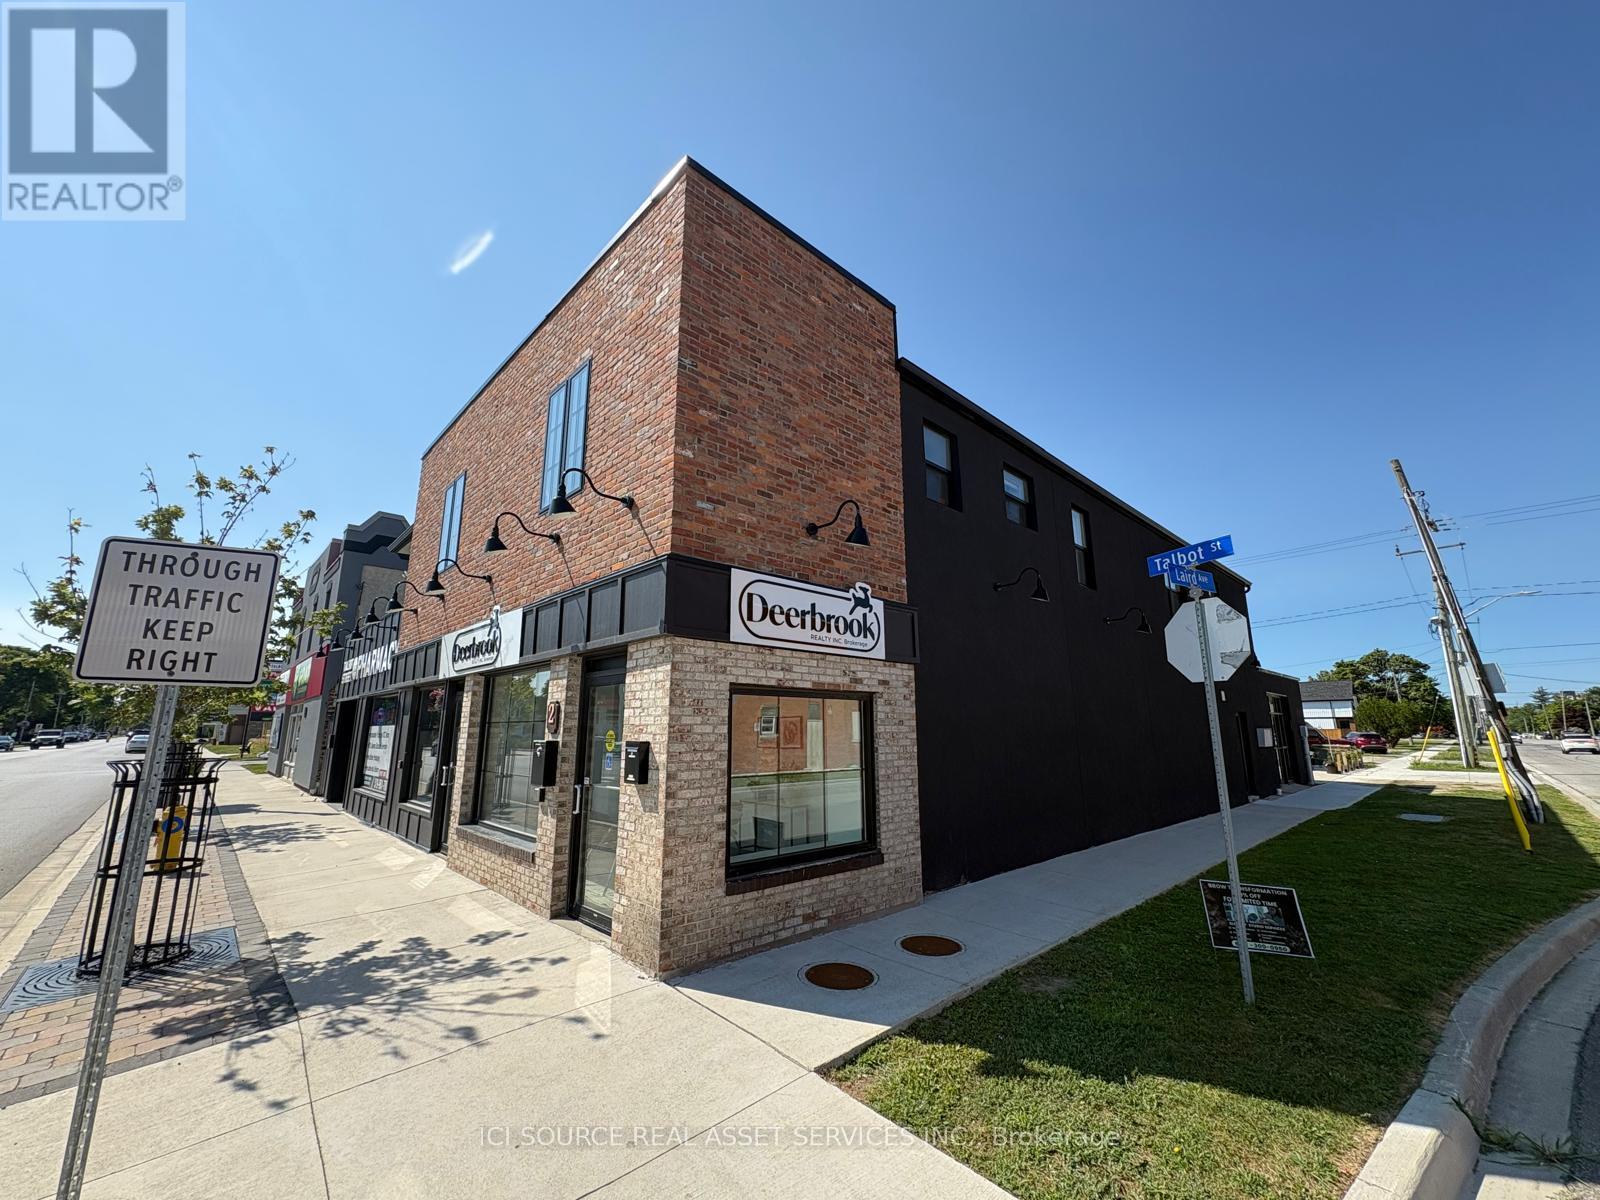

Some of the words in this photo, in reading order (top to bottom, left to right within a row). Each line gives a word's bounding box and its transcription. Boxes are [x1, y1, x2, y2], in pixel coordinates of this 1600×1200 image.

[122, 551, 262, 583] THROUGH
[1154, 546, 1204, 571] Talbot
[1175, 568, 1197, 584] Laird
[128, 583, 244, 613] TRAFFIC
[746, 592, 876, 641] Deerbrook
[142, 618, 214, 642] KEEP
[811, 633, 832, 643] REALTY
[844, 639, 868, 648] Brokerage
[126, 648, 218, 673] RIGHT
[548, 703, 555, 723] 2
